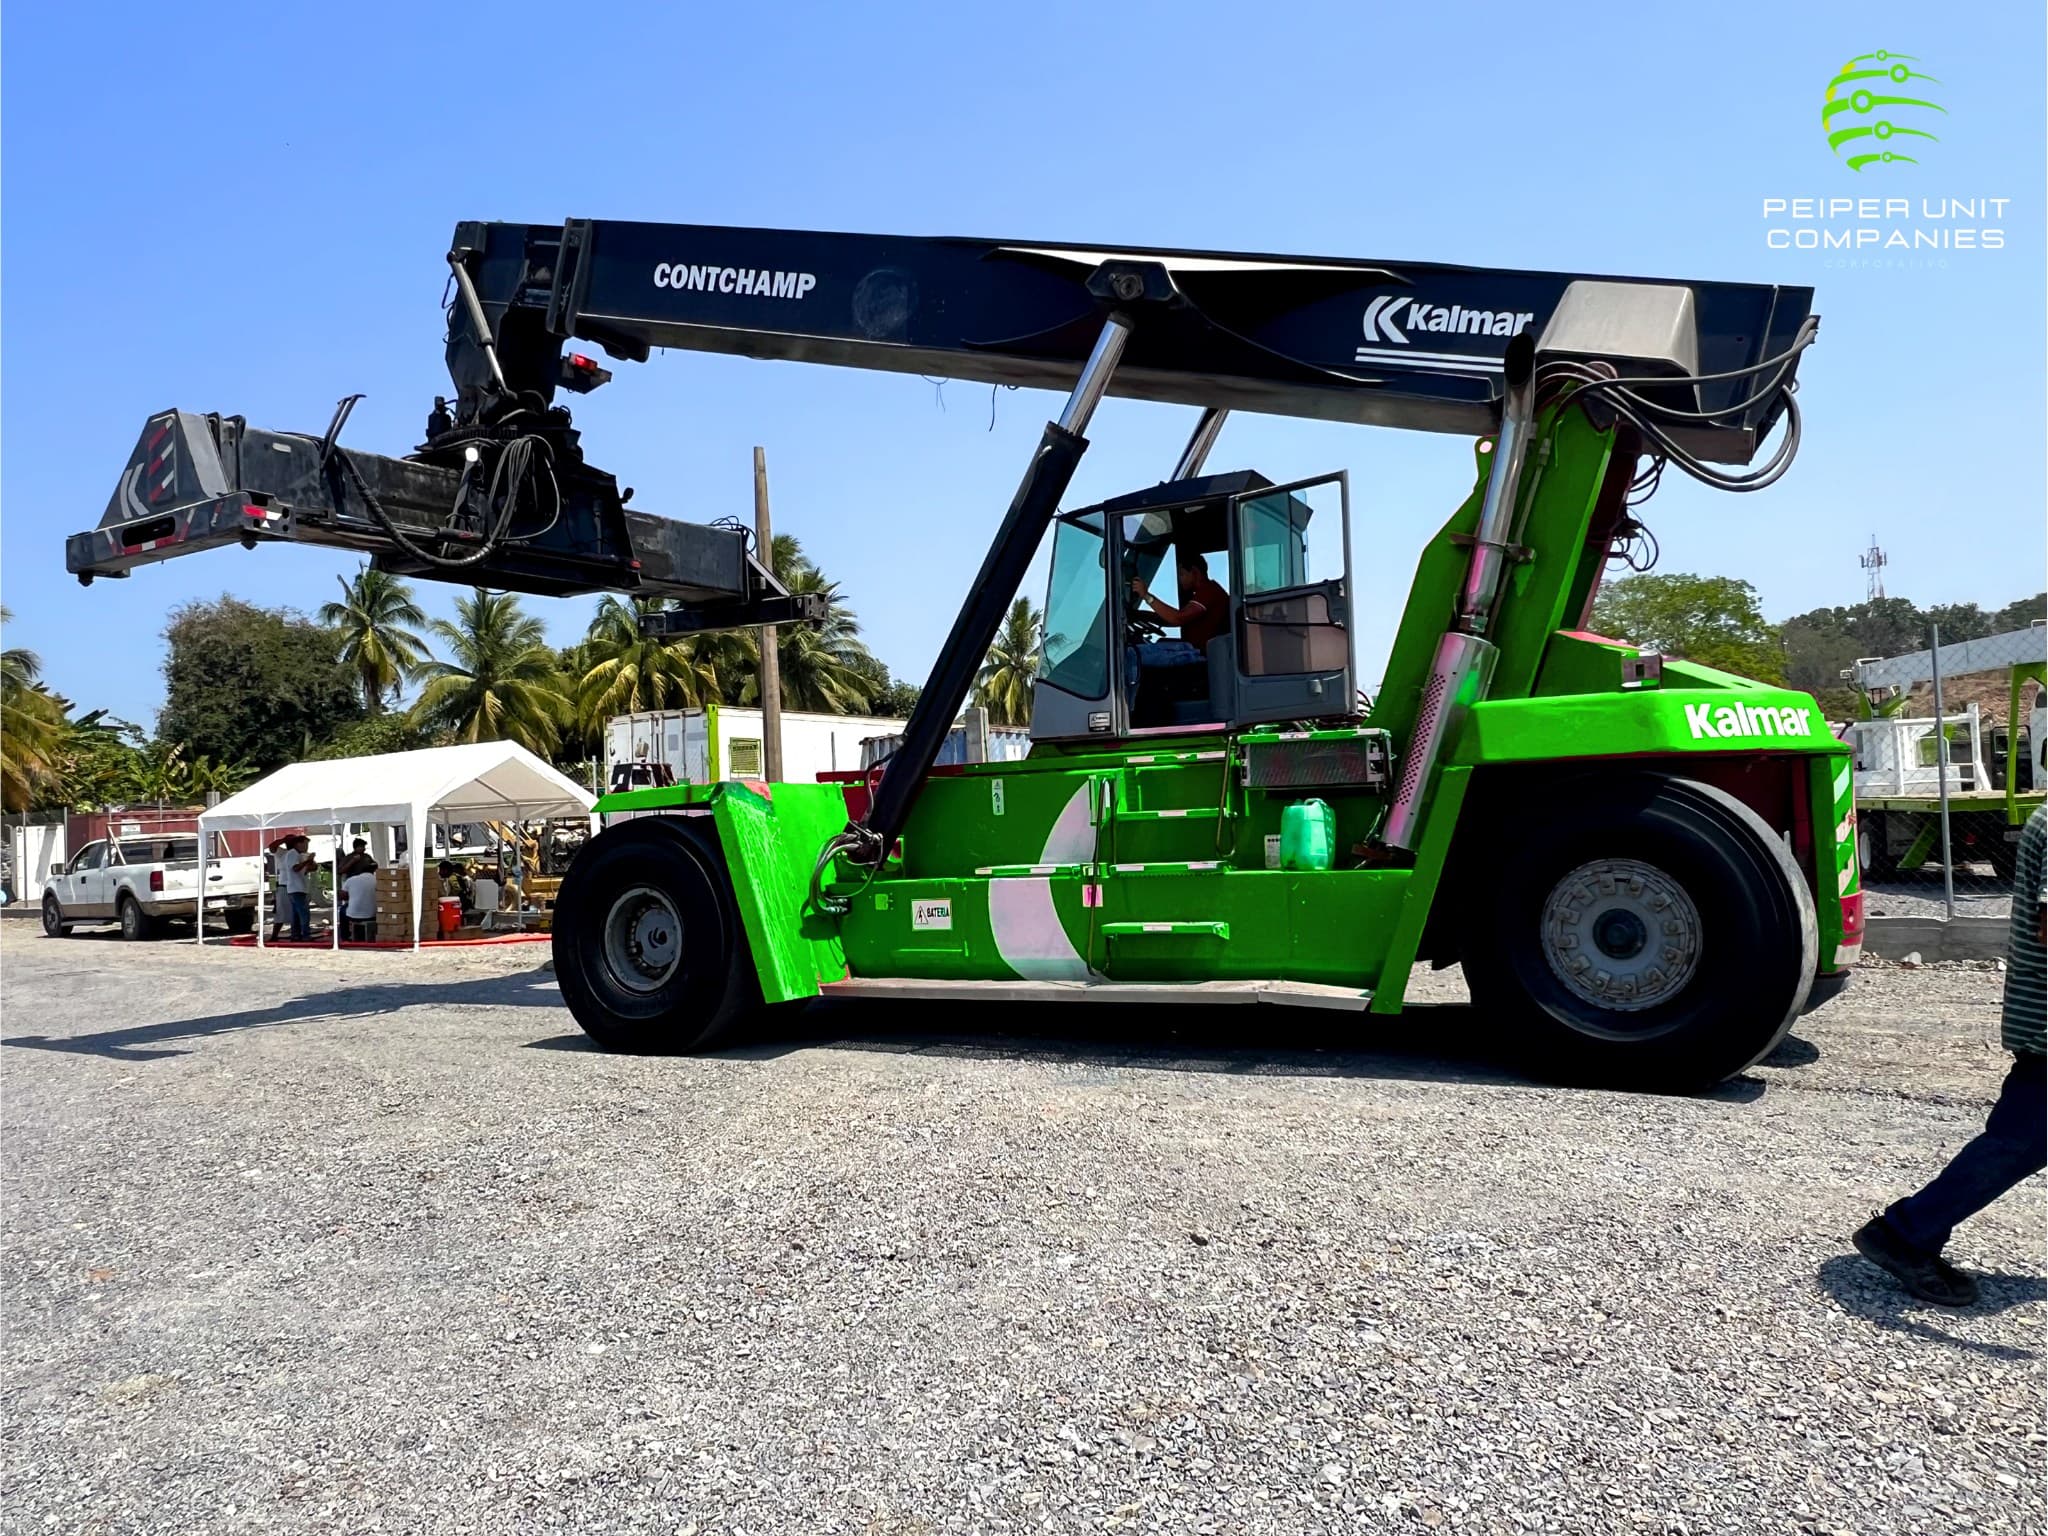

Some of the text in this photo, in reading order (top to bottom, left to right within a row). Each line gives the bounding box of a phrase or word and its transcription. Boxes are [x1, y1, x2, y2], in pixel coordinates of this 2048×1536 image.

[653, 262, 817, 300] CONTCHAMP
[1406, 303, 1535, 338] Kalmar
[1683, 701, 1812, 739] Kalmar
